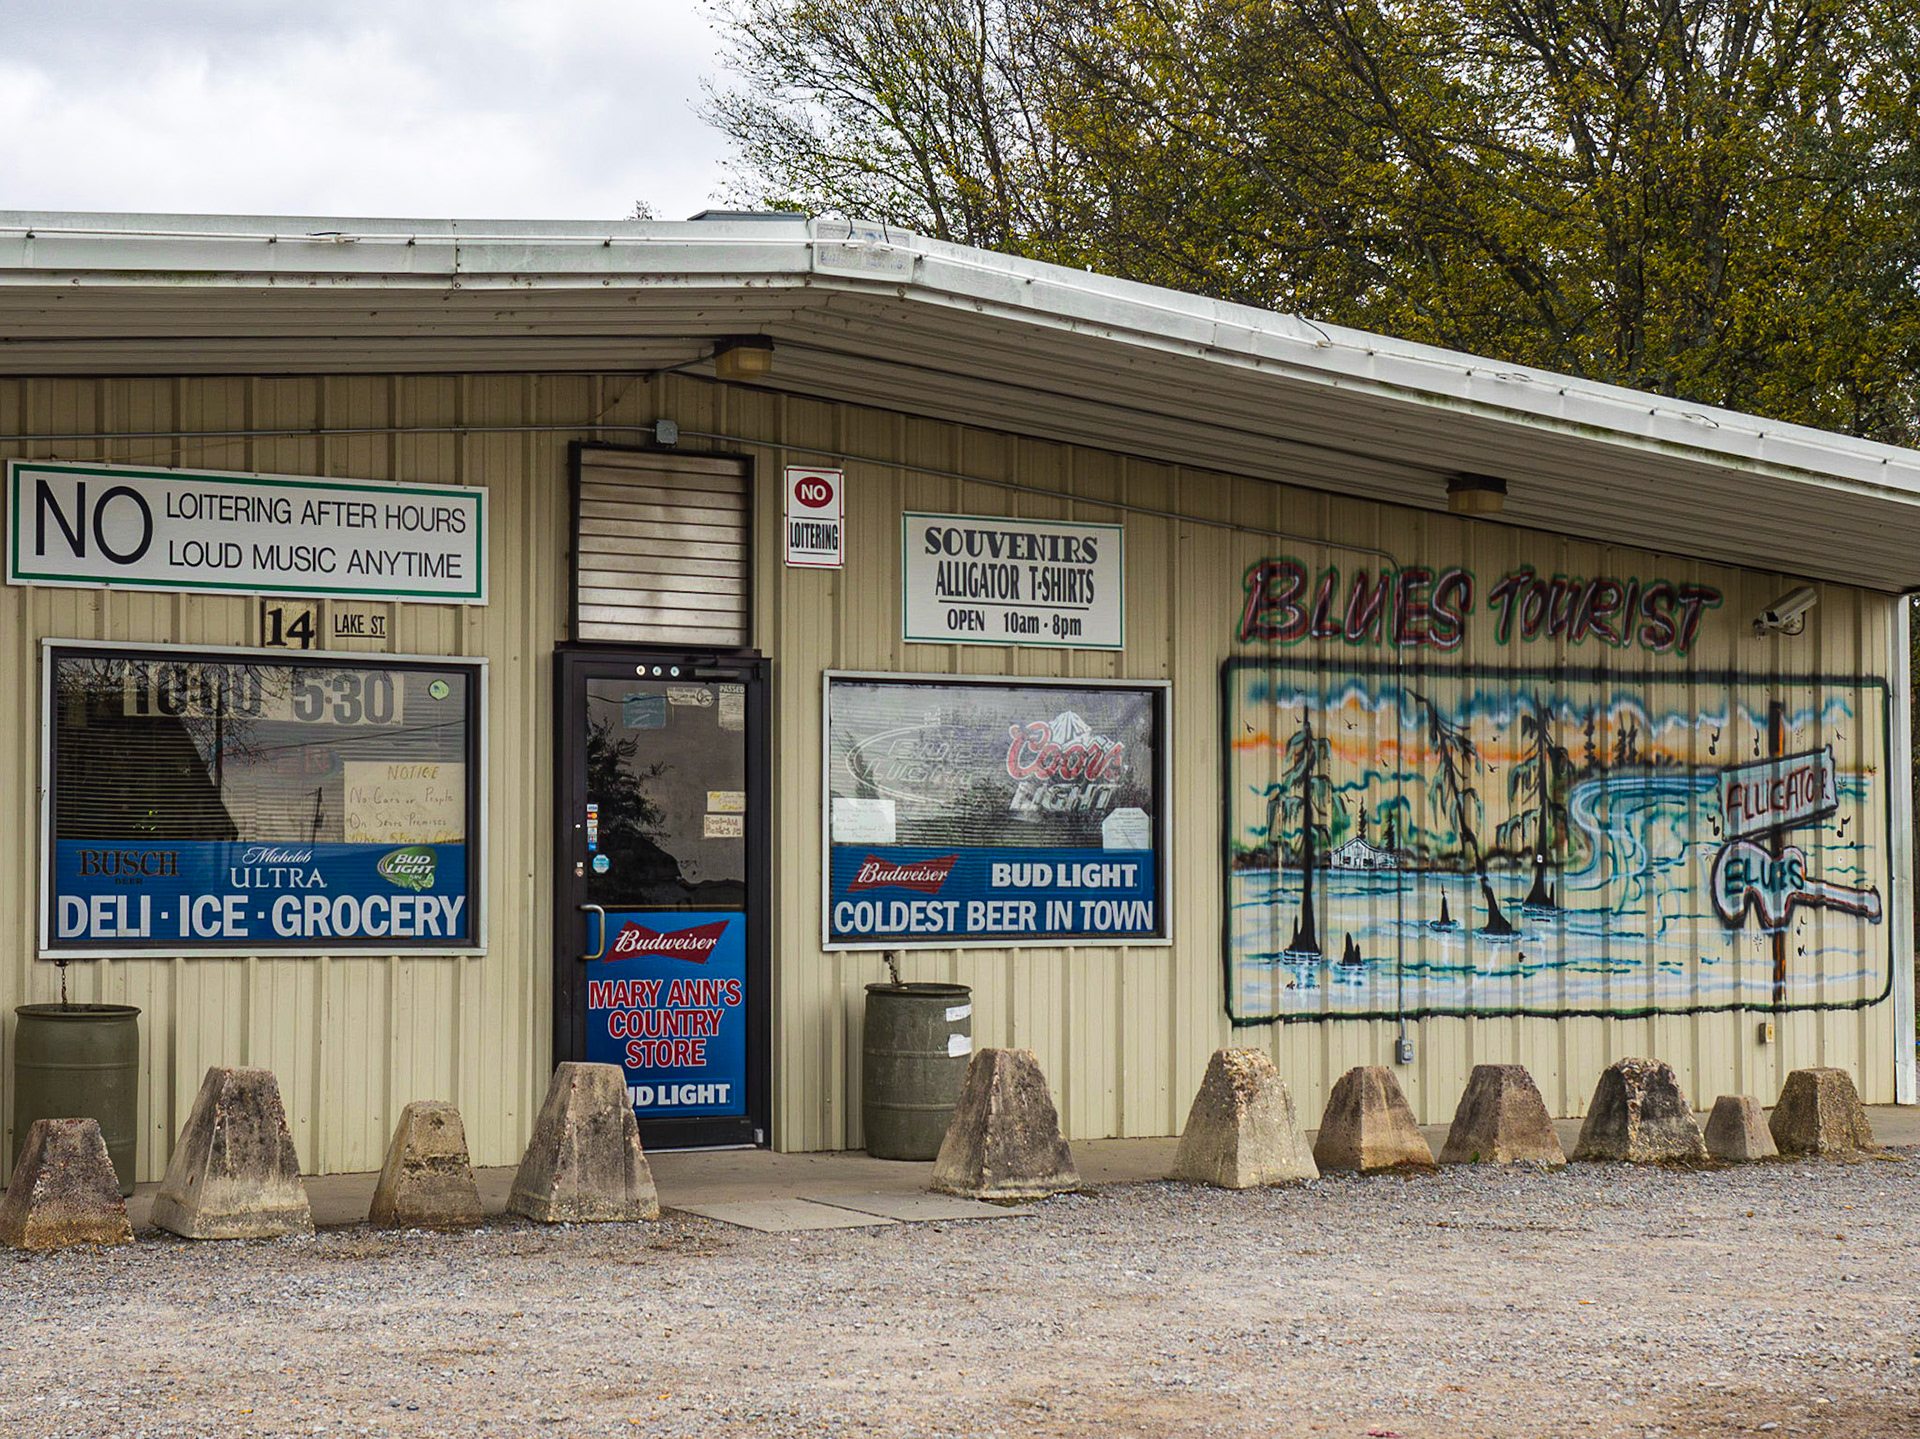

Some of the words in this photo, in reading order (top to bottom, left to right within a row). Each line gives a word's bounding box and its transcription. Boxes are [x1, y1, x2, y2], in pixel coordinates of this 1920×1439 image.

[801, 484, 826, 501] NO
[35, 479, 153, 565] NO
[167, 492, 292, 525] LOITERING
[300, 499, 377, 528] AFTER
[386, 504, 466, 533] HOURS
[790, 522, 838, 551] LOITERING
[925, 526, 1098, 564] SOUVENIRS
[169, 540, 243, 569] LOUD
[253, 544, 336, 573] MUSIC
[347, 548, 462, 579] ANYTIME
[935, 560, 1019, 600] ALLIGATOR
[1029, 565, 1094, 604] T-SHIRTS
[1242, 562, 1473, 650] BLUES
[1489, 568, 1721, 655] TOURIST
[266, 608, 314, 649] 14
[335, 614, 364, 633] LAKE
[371, 615, 386, 635] ST.
[947, 609, 985, 631] OPEN
[1003, 612, 1039, 634] 10am
[1053, 613, 1082, 639] 8pm
[295, 668, 394, 724] 5:30
[719, 685, 745, 693] PASSED
[1007, 721, 1124, 780] Coors
[388, 765, 440, 780] NOTICE
[350, 787, 367, 803] No
[374, 787, 399, 804] Cars
[1726, 764, 1830, 823] ALLIGATOR
[350, 812, 367, 829] On
[76, 849, 180, 876] BUSCH
[242, 847, 312, 864] Michelob
[387, 864, 435, 873] LIGHT
[395, 854, 431, 864] BUD
[230, 867, 327, 888] ULTRA
[858, 863, 948, 883] Budweiser
[992, 863, 1052, 887] BUD
[1056, 864, 1137, 887] LIGHT
[58, 895, 151, 938] DELI
[180, 895, 248, 938] ICE
[271, 895, 466, 937] GROCERY
[834, 901, 960, 933] COLDEST
[967, 901, 1036, 931] BEER
[1046, 901, 1073, 930] IN
[1080, 900, 1154, 931] TOWN
[614, 929, 718, 952] Budweiser
[588, 979, 663, 1009] MARY
[666, 978, 742, 1007] ANN'S
[608, 1009, 725, 1038] COUNTRY
[625, 1038, 707, 1069] STORE
[657, 1083, 731, 1106] LIGHT
